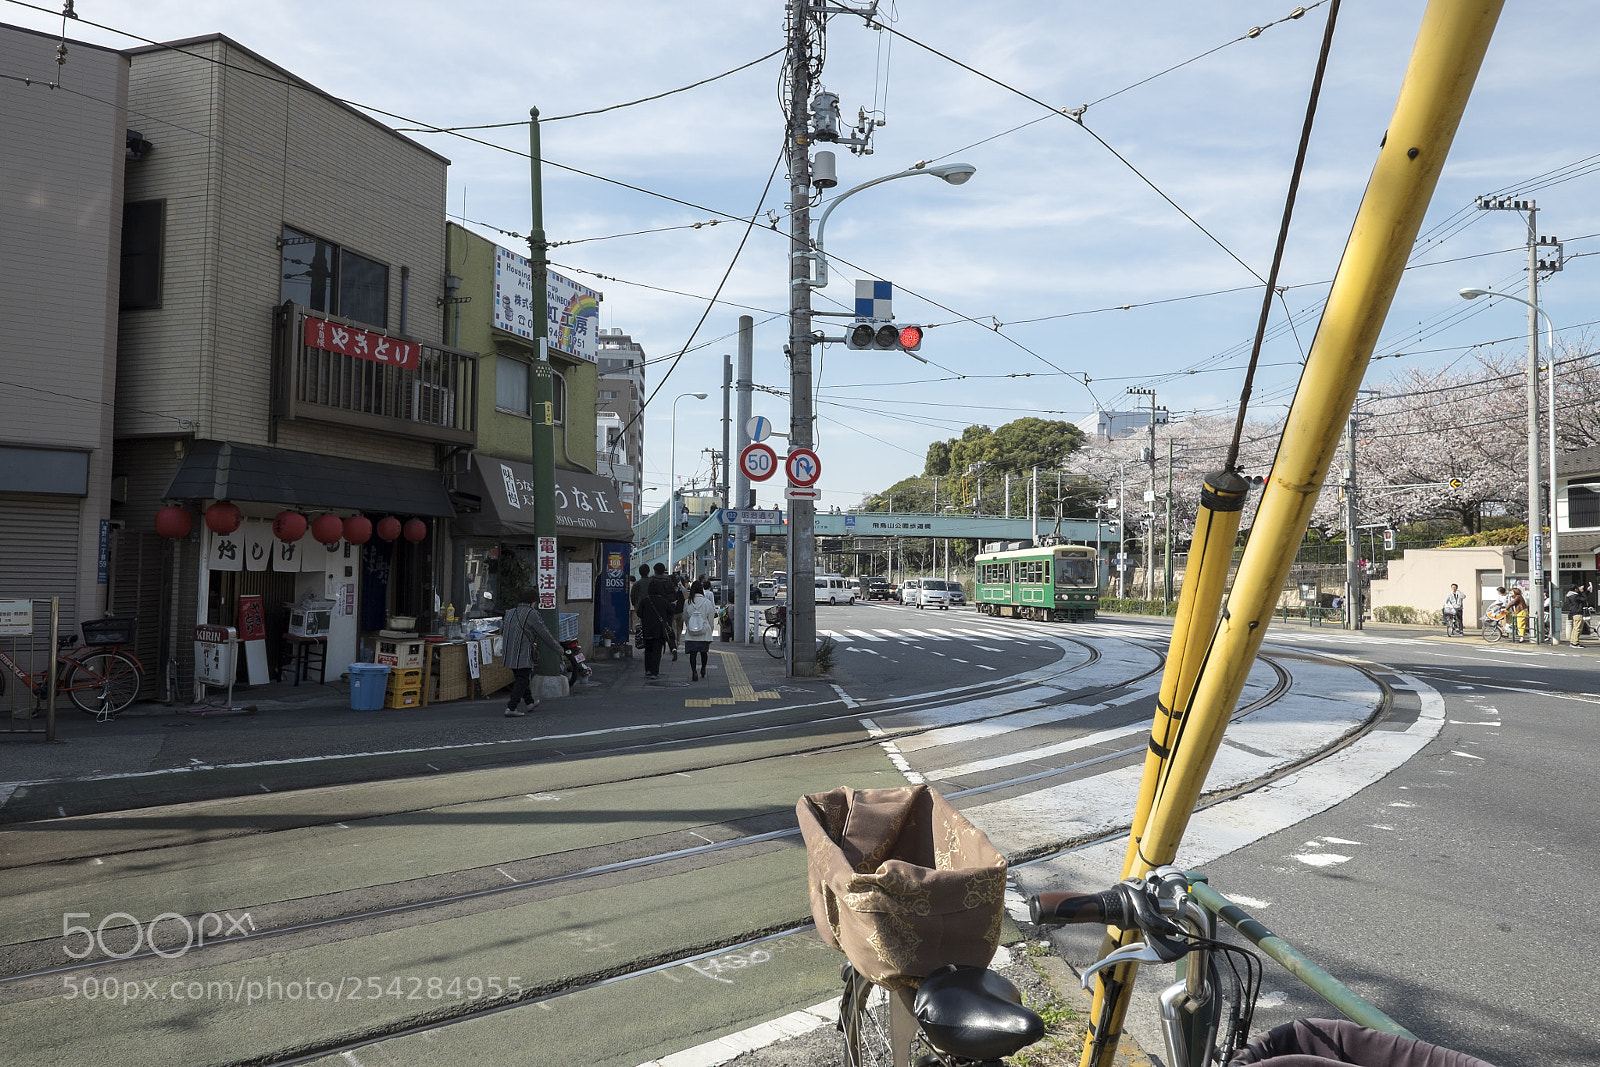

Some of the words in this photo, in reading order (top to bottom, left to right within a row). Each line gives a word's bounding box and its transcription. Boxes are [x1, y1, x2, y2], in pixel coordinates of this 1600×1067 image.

[507, 263, 531, 281] Housing
[331, 327, 410, 364] やきとり
[748, 454, 769, 471] 50
[516, 478, 534, 491] うな
[872, 522, 931, 530] 飛鳥山公園歩道橋
[539, 537, 555, 609] 電車注意
[605, 578, 624, 587] BOSS
[196, 629, 221, 642] KIRIN
